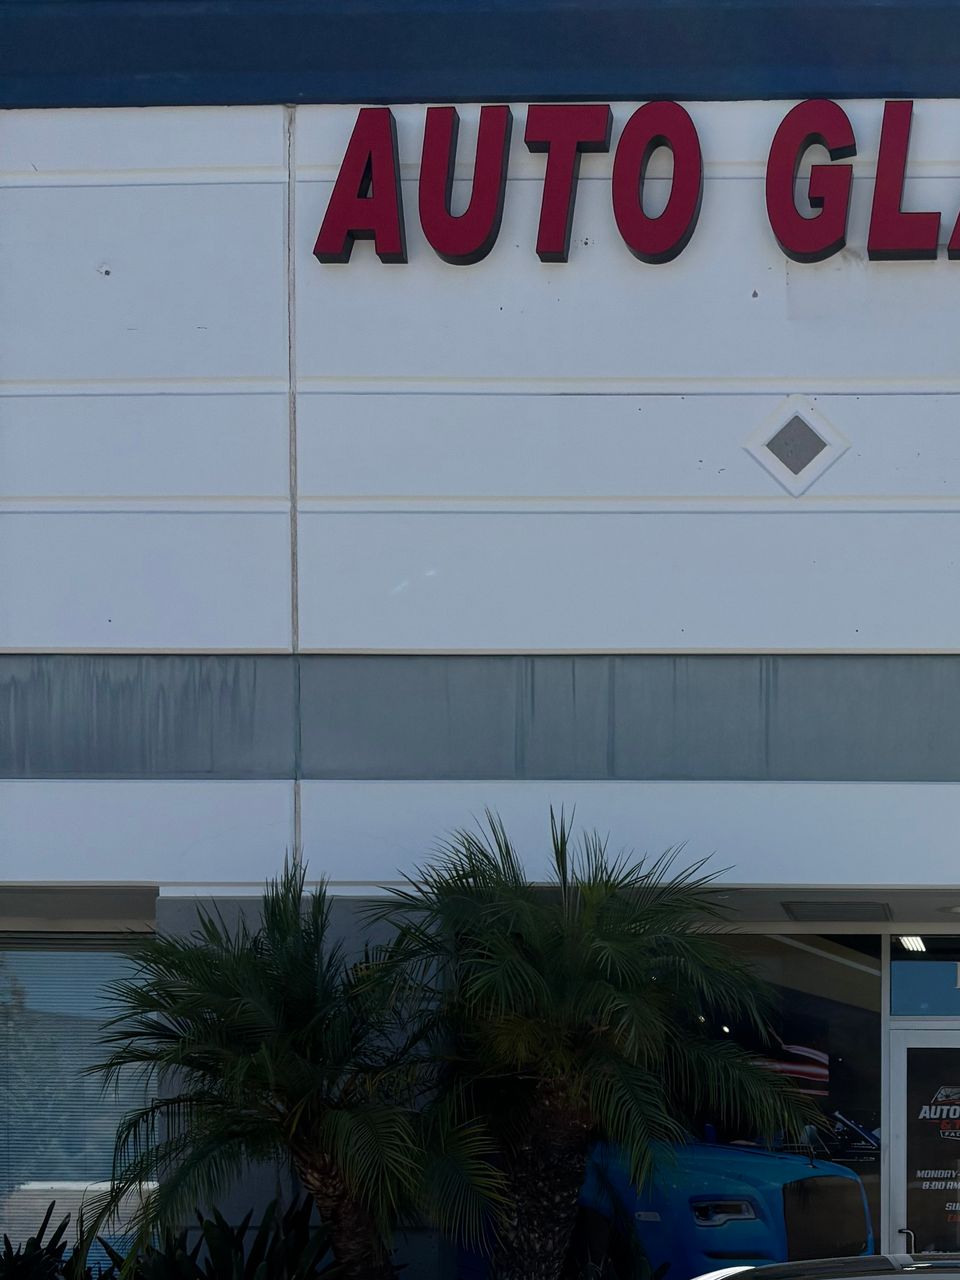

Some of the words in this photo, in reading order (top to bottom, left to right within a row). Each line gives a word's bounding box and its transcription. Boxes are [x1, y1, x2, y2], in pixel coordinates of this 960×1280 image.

[313, 100, 704, 266] AUTO
[918, 1105, 960, 1120] AUTO
[922, 1181, 946, 1190] 8:00
[946, 1181, 960, 1190] AM
